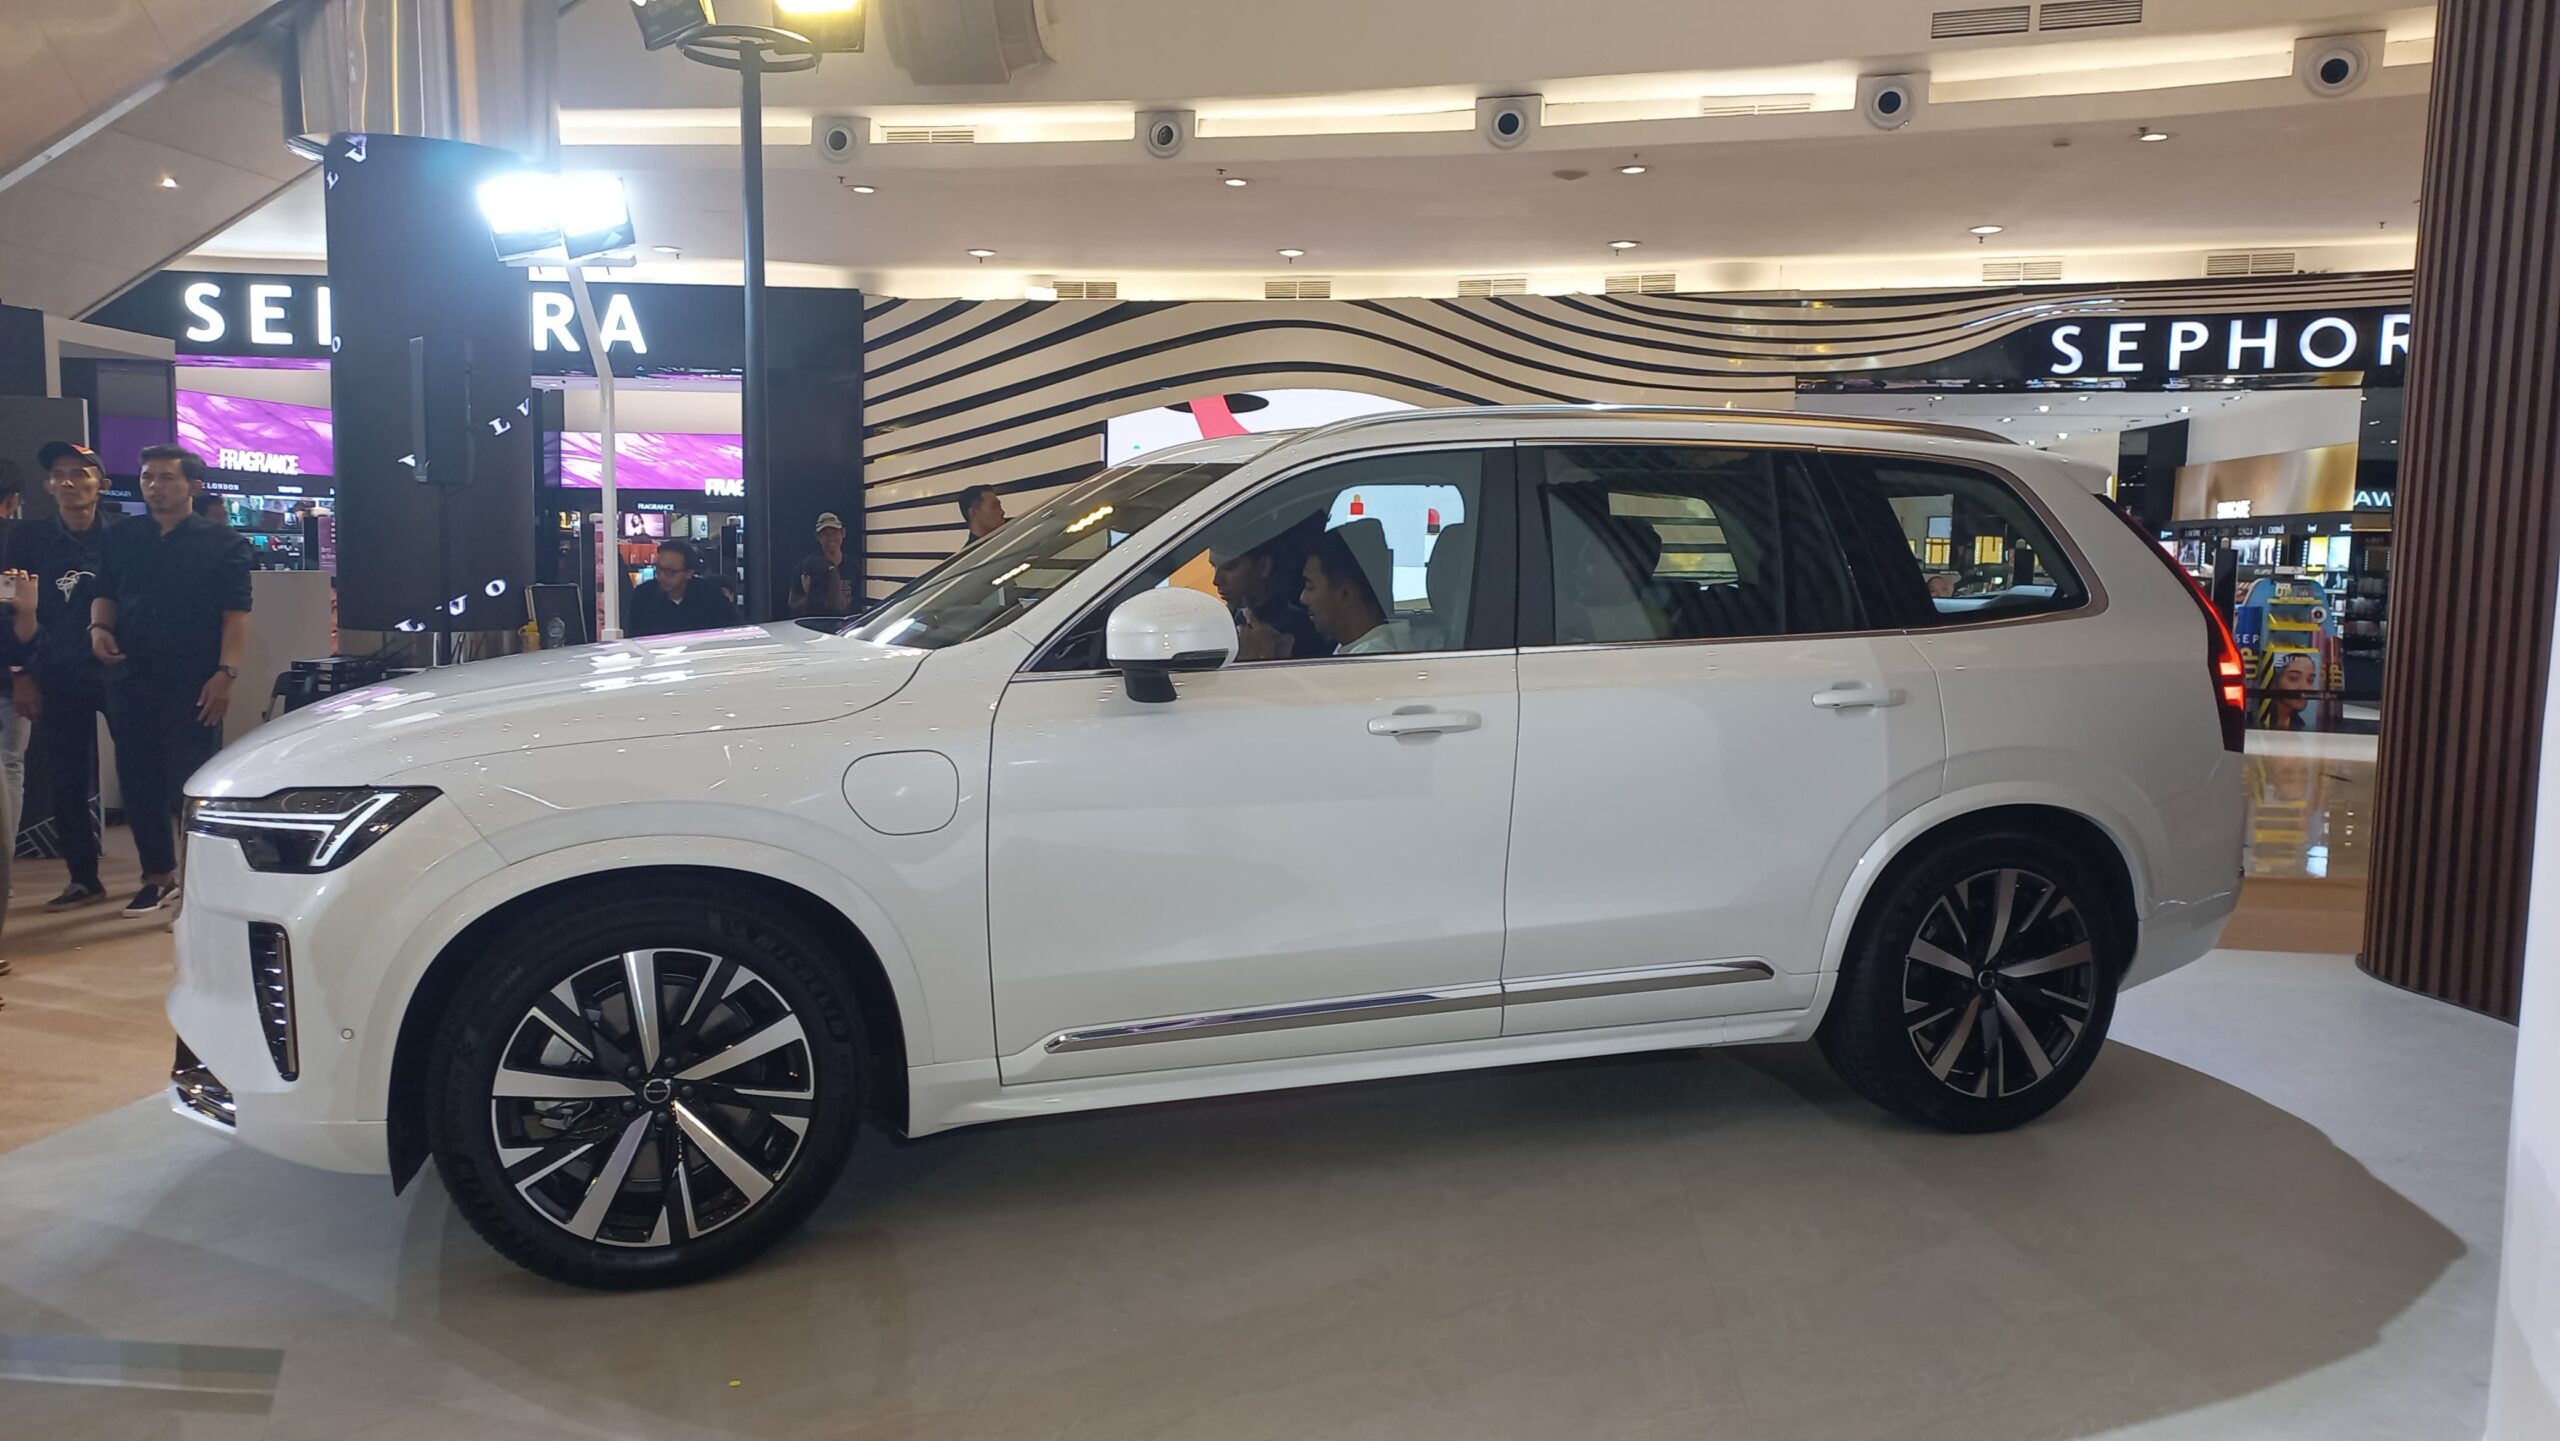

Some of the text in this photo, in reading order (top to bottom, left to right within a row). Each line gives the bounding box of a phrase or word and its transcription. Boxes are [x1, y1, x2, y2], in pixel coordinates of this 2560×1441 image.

[2050, 314, 2412, 375] SEPHOR
[219, 447, 299, 475] FRAGRANCE
[207, 482, 240, 491] LONDON
[637, 502, 675, 511] FRAGRANCE
